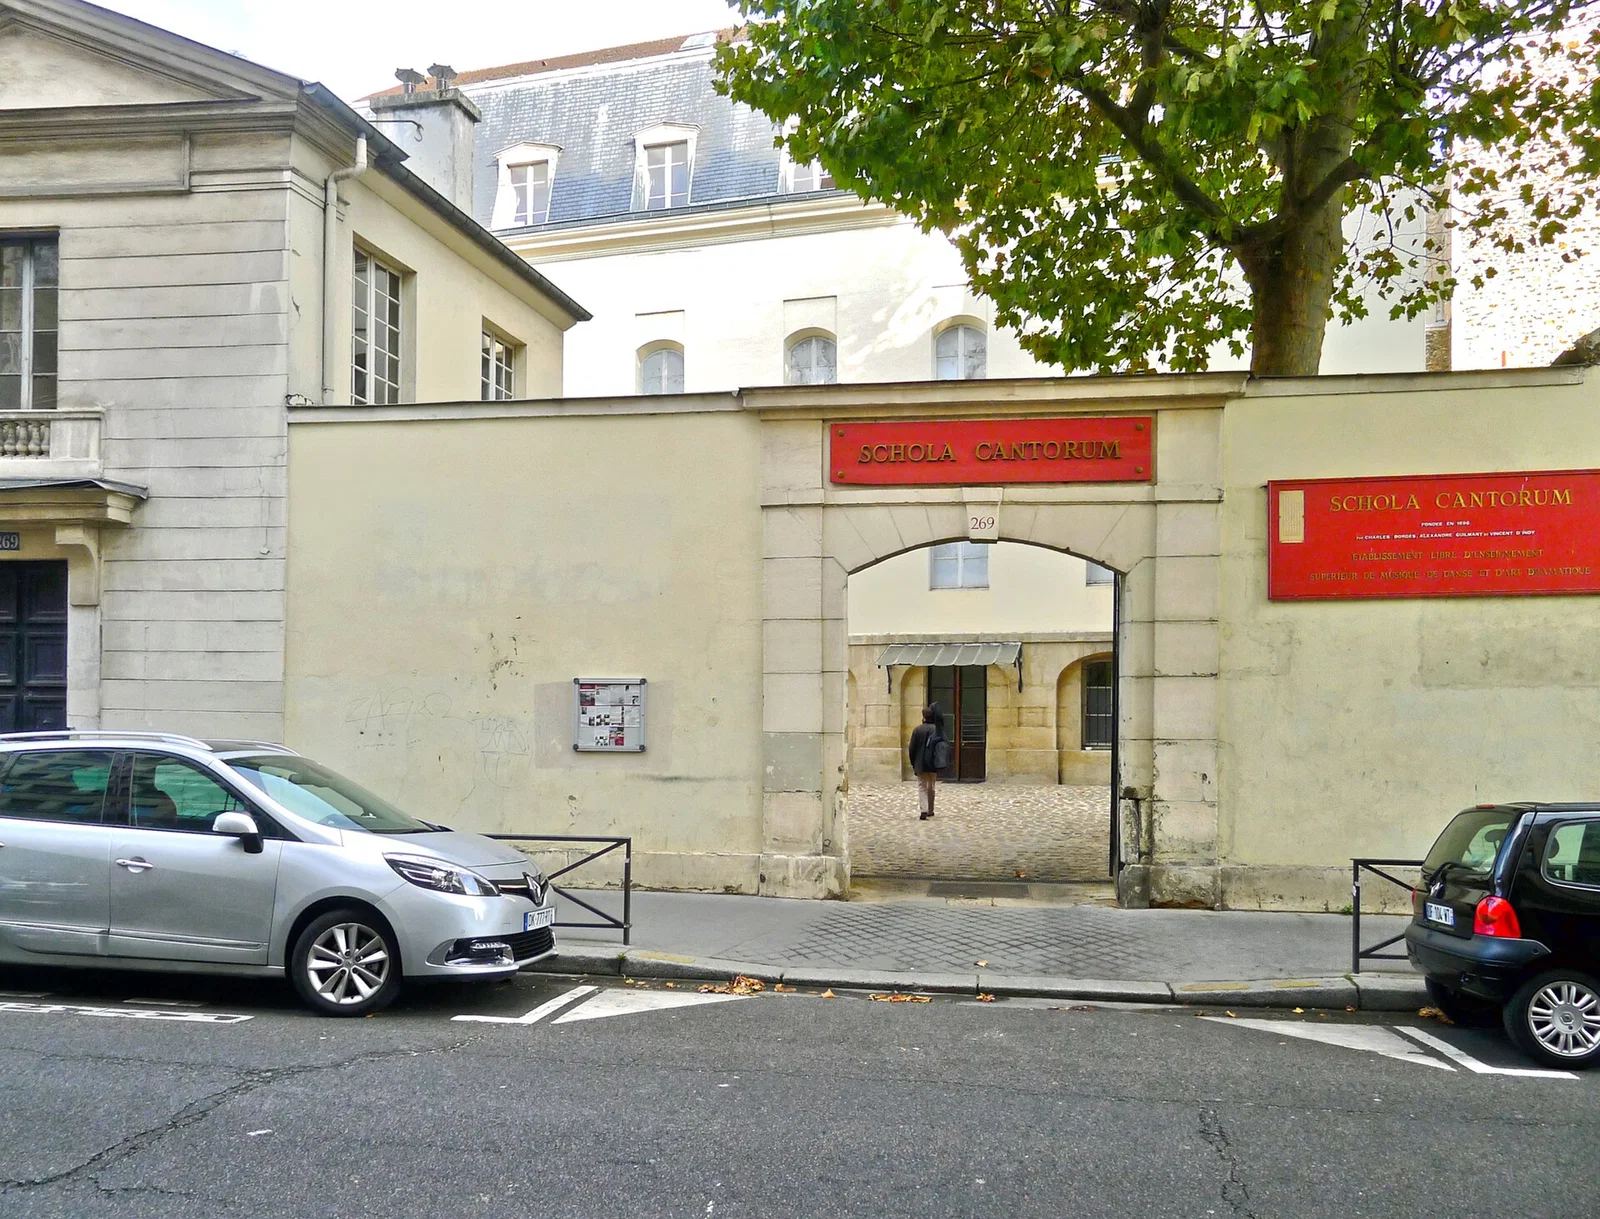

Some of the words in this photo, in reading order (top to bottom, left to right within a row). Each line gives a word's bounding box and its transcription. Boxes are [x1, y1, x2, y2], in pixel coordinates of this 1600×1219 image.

[858, 443, 956, 463] SCHOLA
[975, 440, 1122, 460] CANTORUM
[1329, 494, 1421, 512] SCHOLA
[1435, 488, 1573, 509] CANTORUM
[970, 516, 995, 531] 269
[0, 534, 19, 549] 69
[1430, 551, 1457, 560] LIBRE
[1363, 572, 1374, 580] DE
[1380, 571, 1419, 579] MUSIQUE
[1426, 570, 1438, 578] DE
[1443, 569, 1473, 578] DANSE
[1479, 569, 1490, 577] ET
[1527, 567, 1591, 576] DRAMATIQUE
